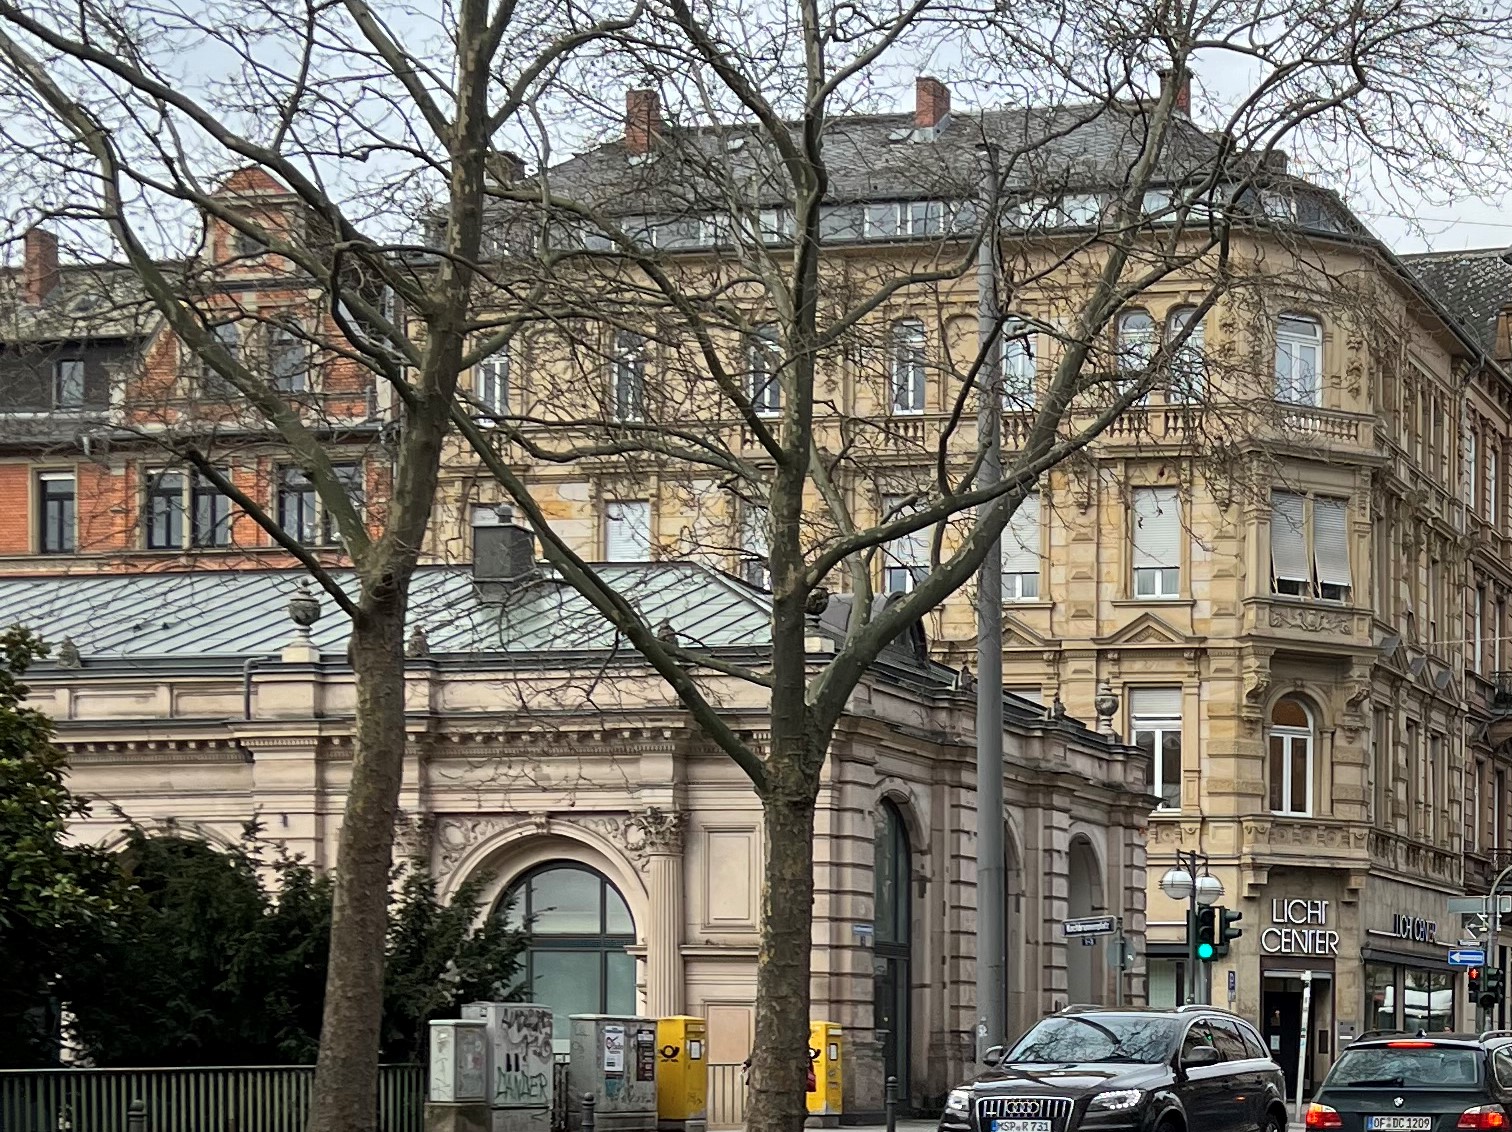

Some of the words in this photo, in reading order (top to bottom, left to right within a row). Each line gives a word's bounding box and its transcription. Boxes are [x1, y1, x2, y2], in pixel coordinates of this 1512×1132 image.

[1271, 898, 1329, 925] LICHT
[1260, 927, 1340, 955] CENTER
[1393, 914, 1413, 940] LICHT
[1414, 917, 1437, 943] CENTER
[1030, 1121, 1049, 1132] 731
[1373, 1117, 1386, 1129] OF
[1392, 1117, 1405, 1129] DC
[1406, 1117, 1430, 1129] 1209
